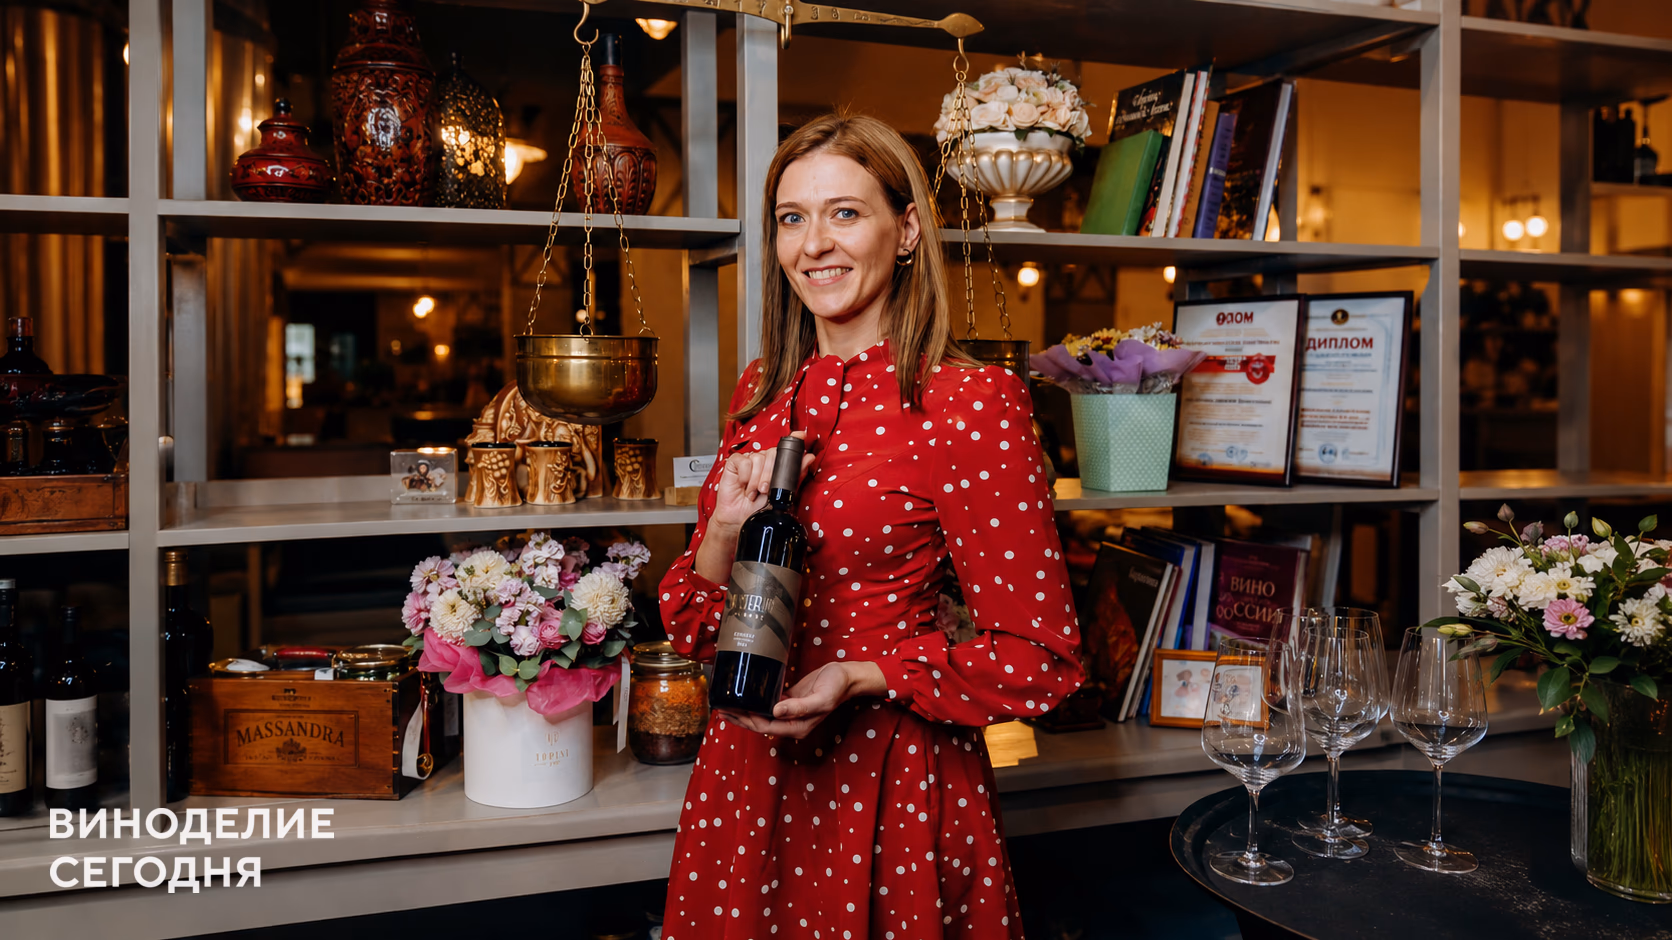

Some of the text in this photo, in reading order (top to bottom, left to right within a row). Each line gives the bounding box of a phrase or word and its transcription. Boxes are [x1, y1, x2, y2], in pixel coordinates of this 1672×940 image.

[1306, 337, 1374, 351] ДИПЛОМ
[1230, 576, 1276, 598] ВИНО
[236, 720, 344, 748] MASSANDRA
